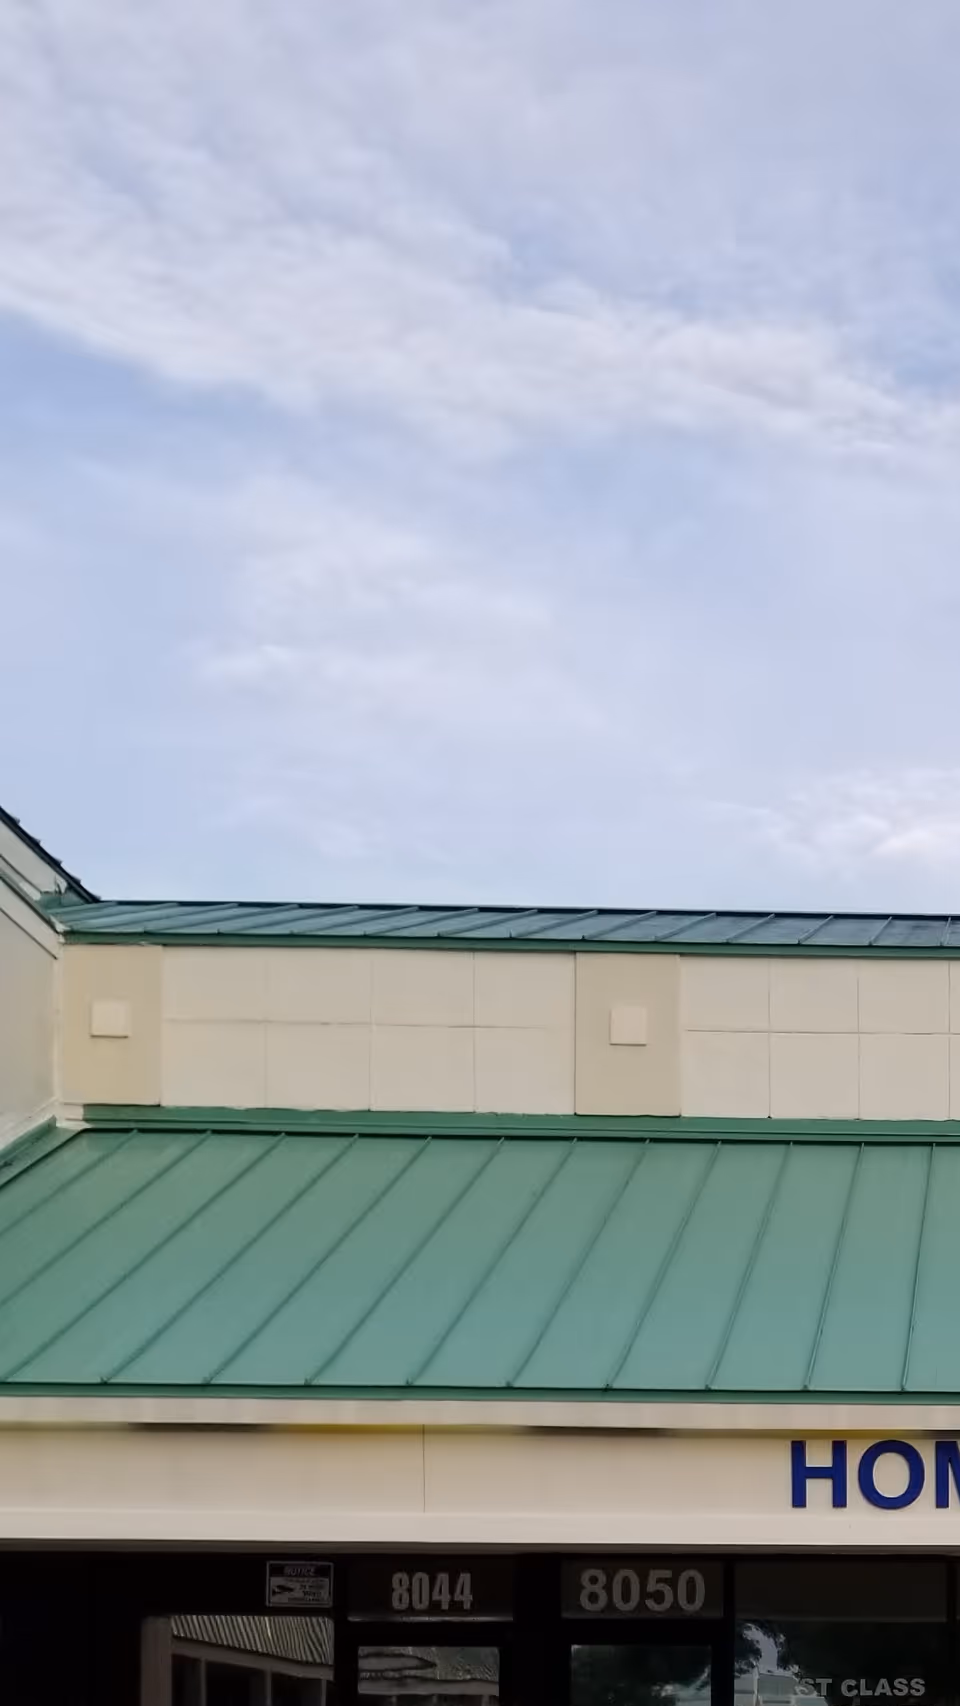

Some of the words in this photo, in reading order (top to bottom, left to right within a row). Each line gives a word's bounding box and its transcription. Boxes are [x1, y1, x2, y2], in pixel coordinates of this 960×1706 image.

[391, 1572, 473, 1610] 8044
[579, 1569, 706, 1612] 8050
[840, 1678, 926, 1697] CLASS
